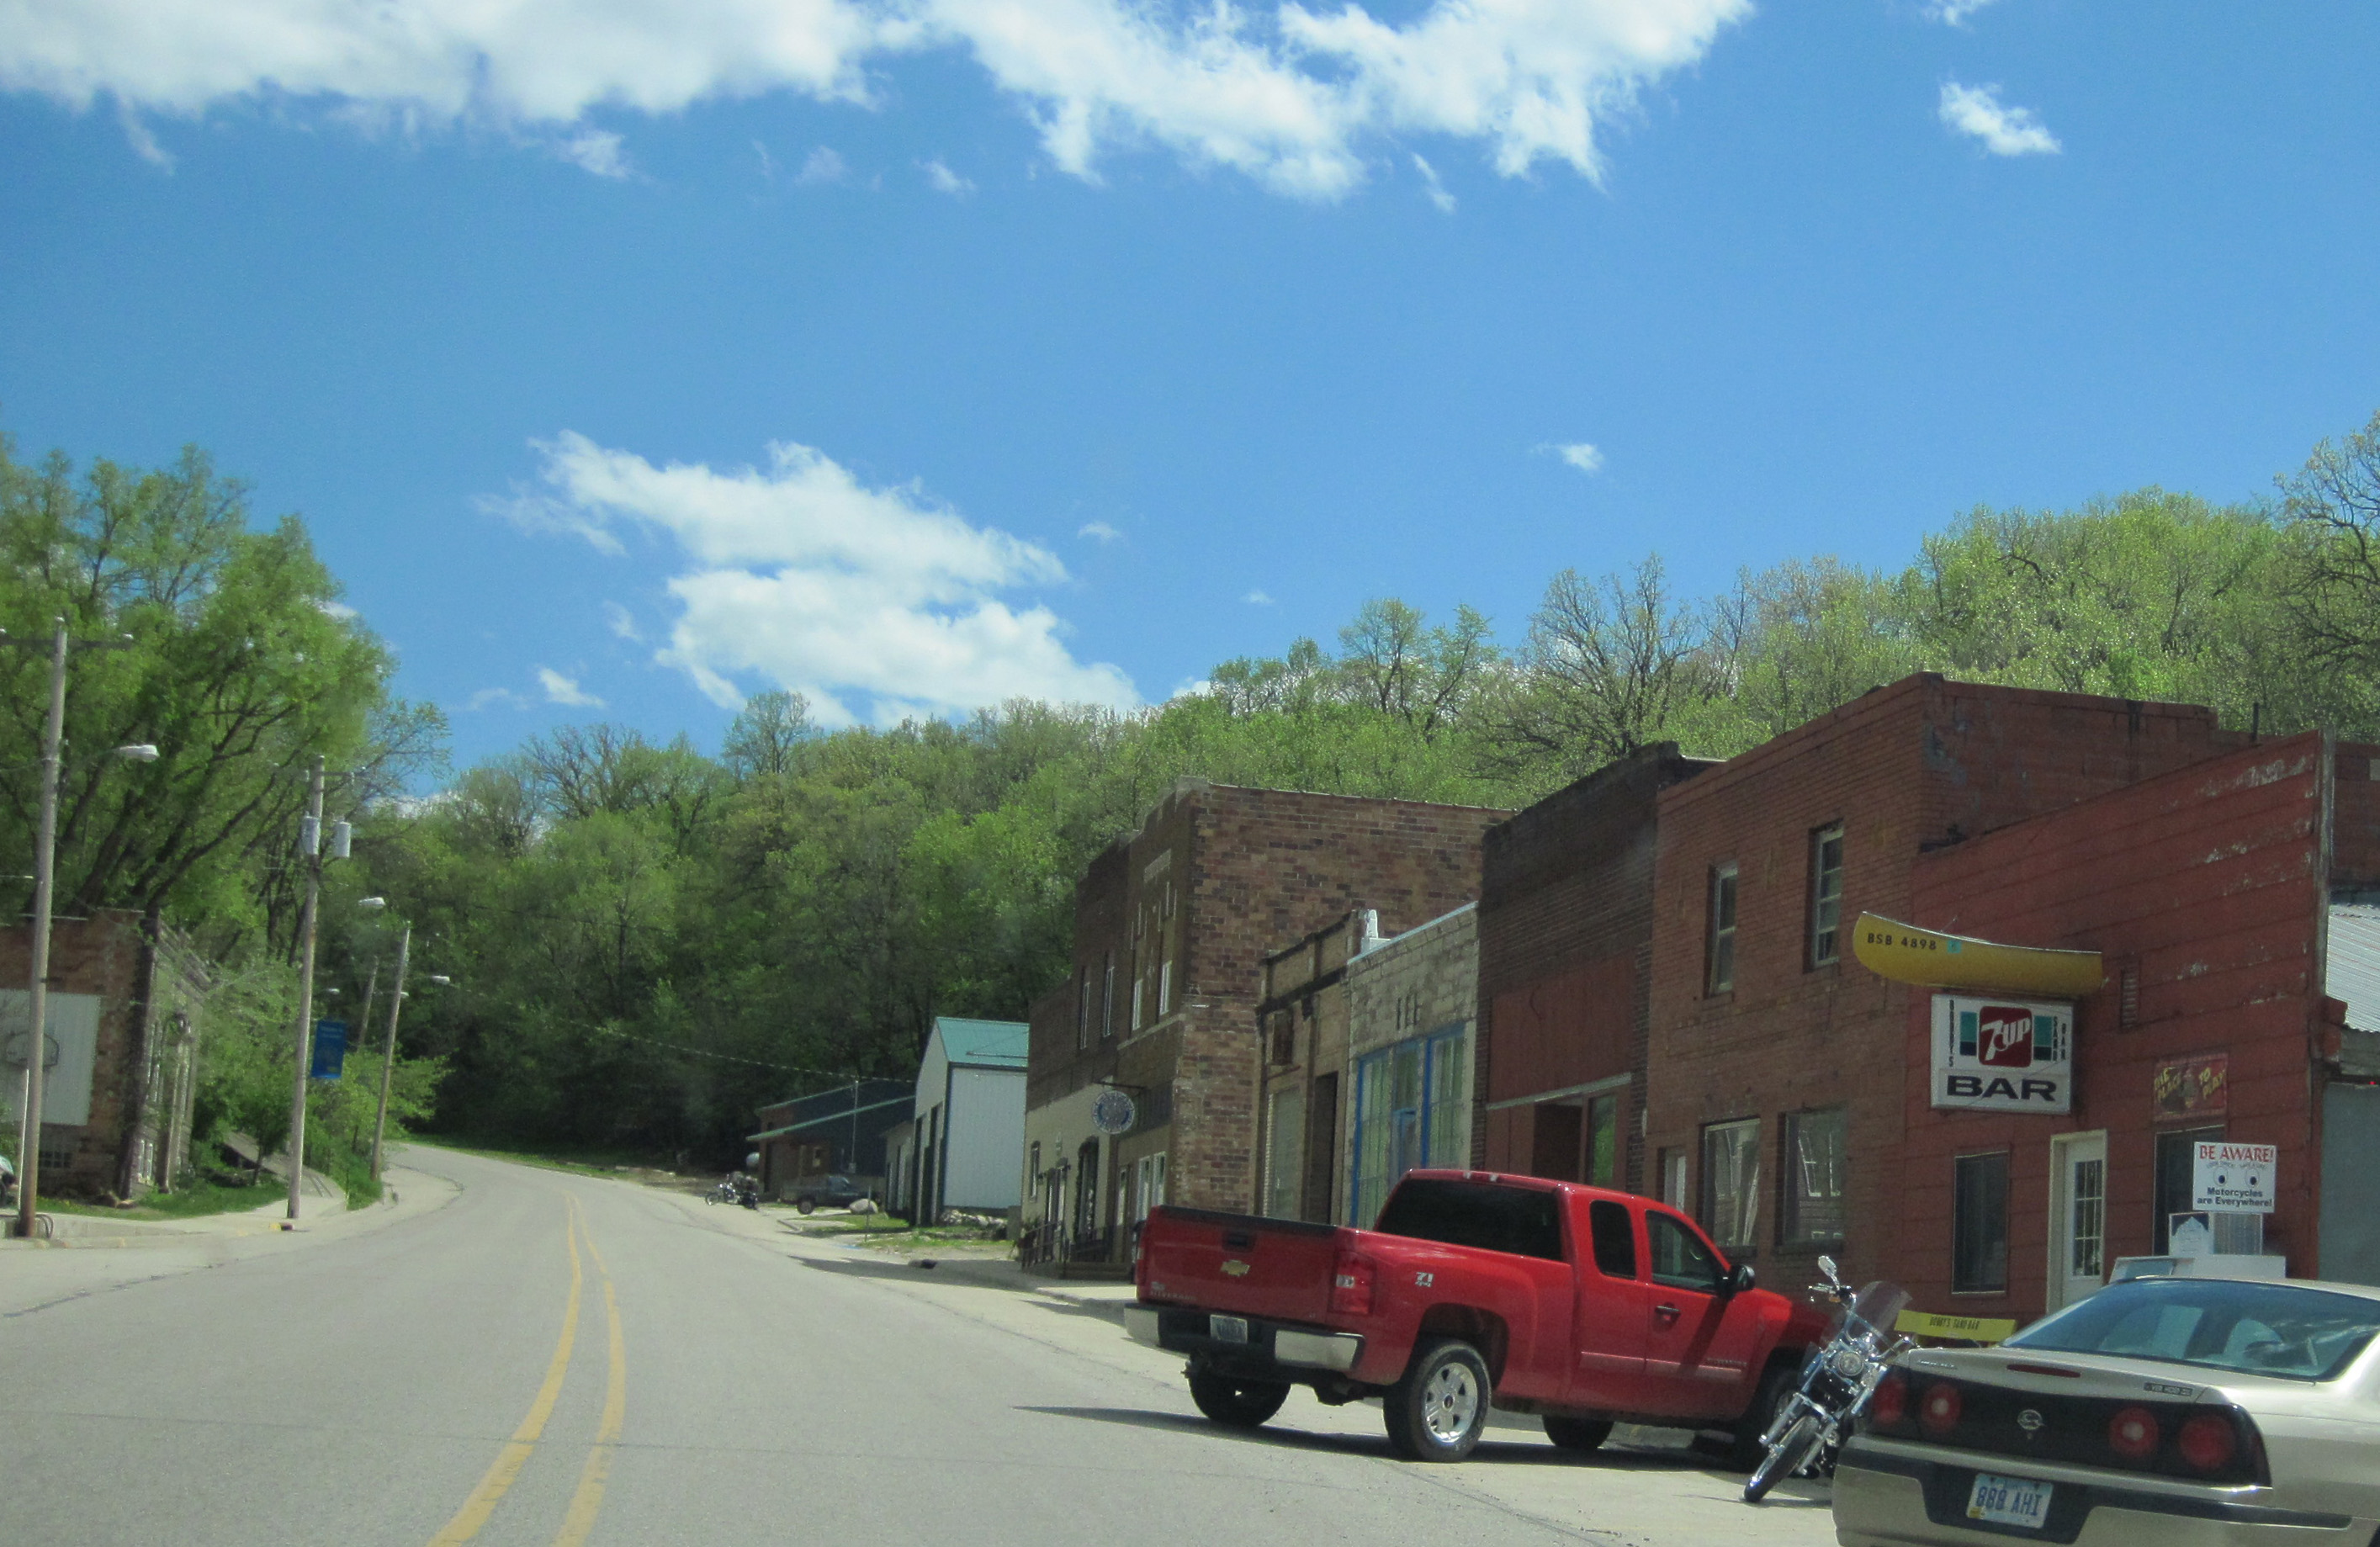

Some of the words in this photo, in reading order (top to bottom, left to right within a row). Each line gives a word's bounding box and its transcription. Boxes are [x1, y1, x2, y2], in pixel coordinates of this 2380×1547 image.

[1868, 932, 1892, 946] BSB
[1901, 936, 1937, 950] 4898
[1947, 1075, 2057, 1101] BAR
[2199, 1145, 2216, 1160] BE
[2220, 1146, 2274, 1163] AWARE!
[2207, 1187, 2263, 1199] Motorcycles
[2215, 1196, 2273, 1207] Everywhere!
